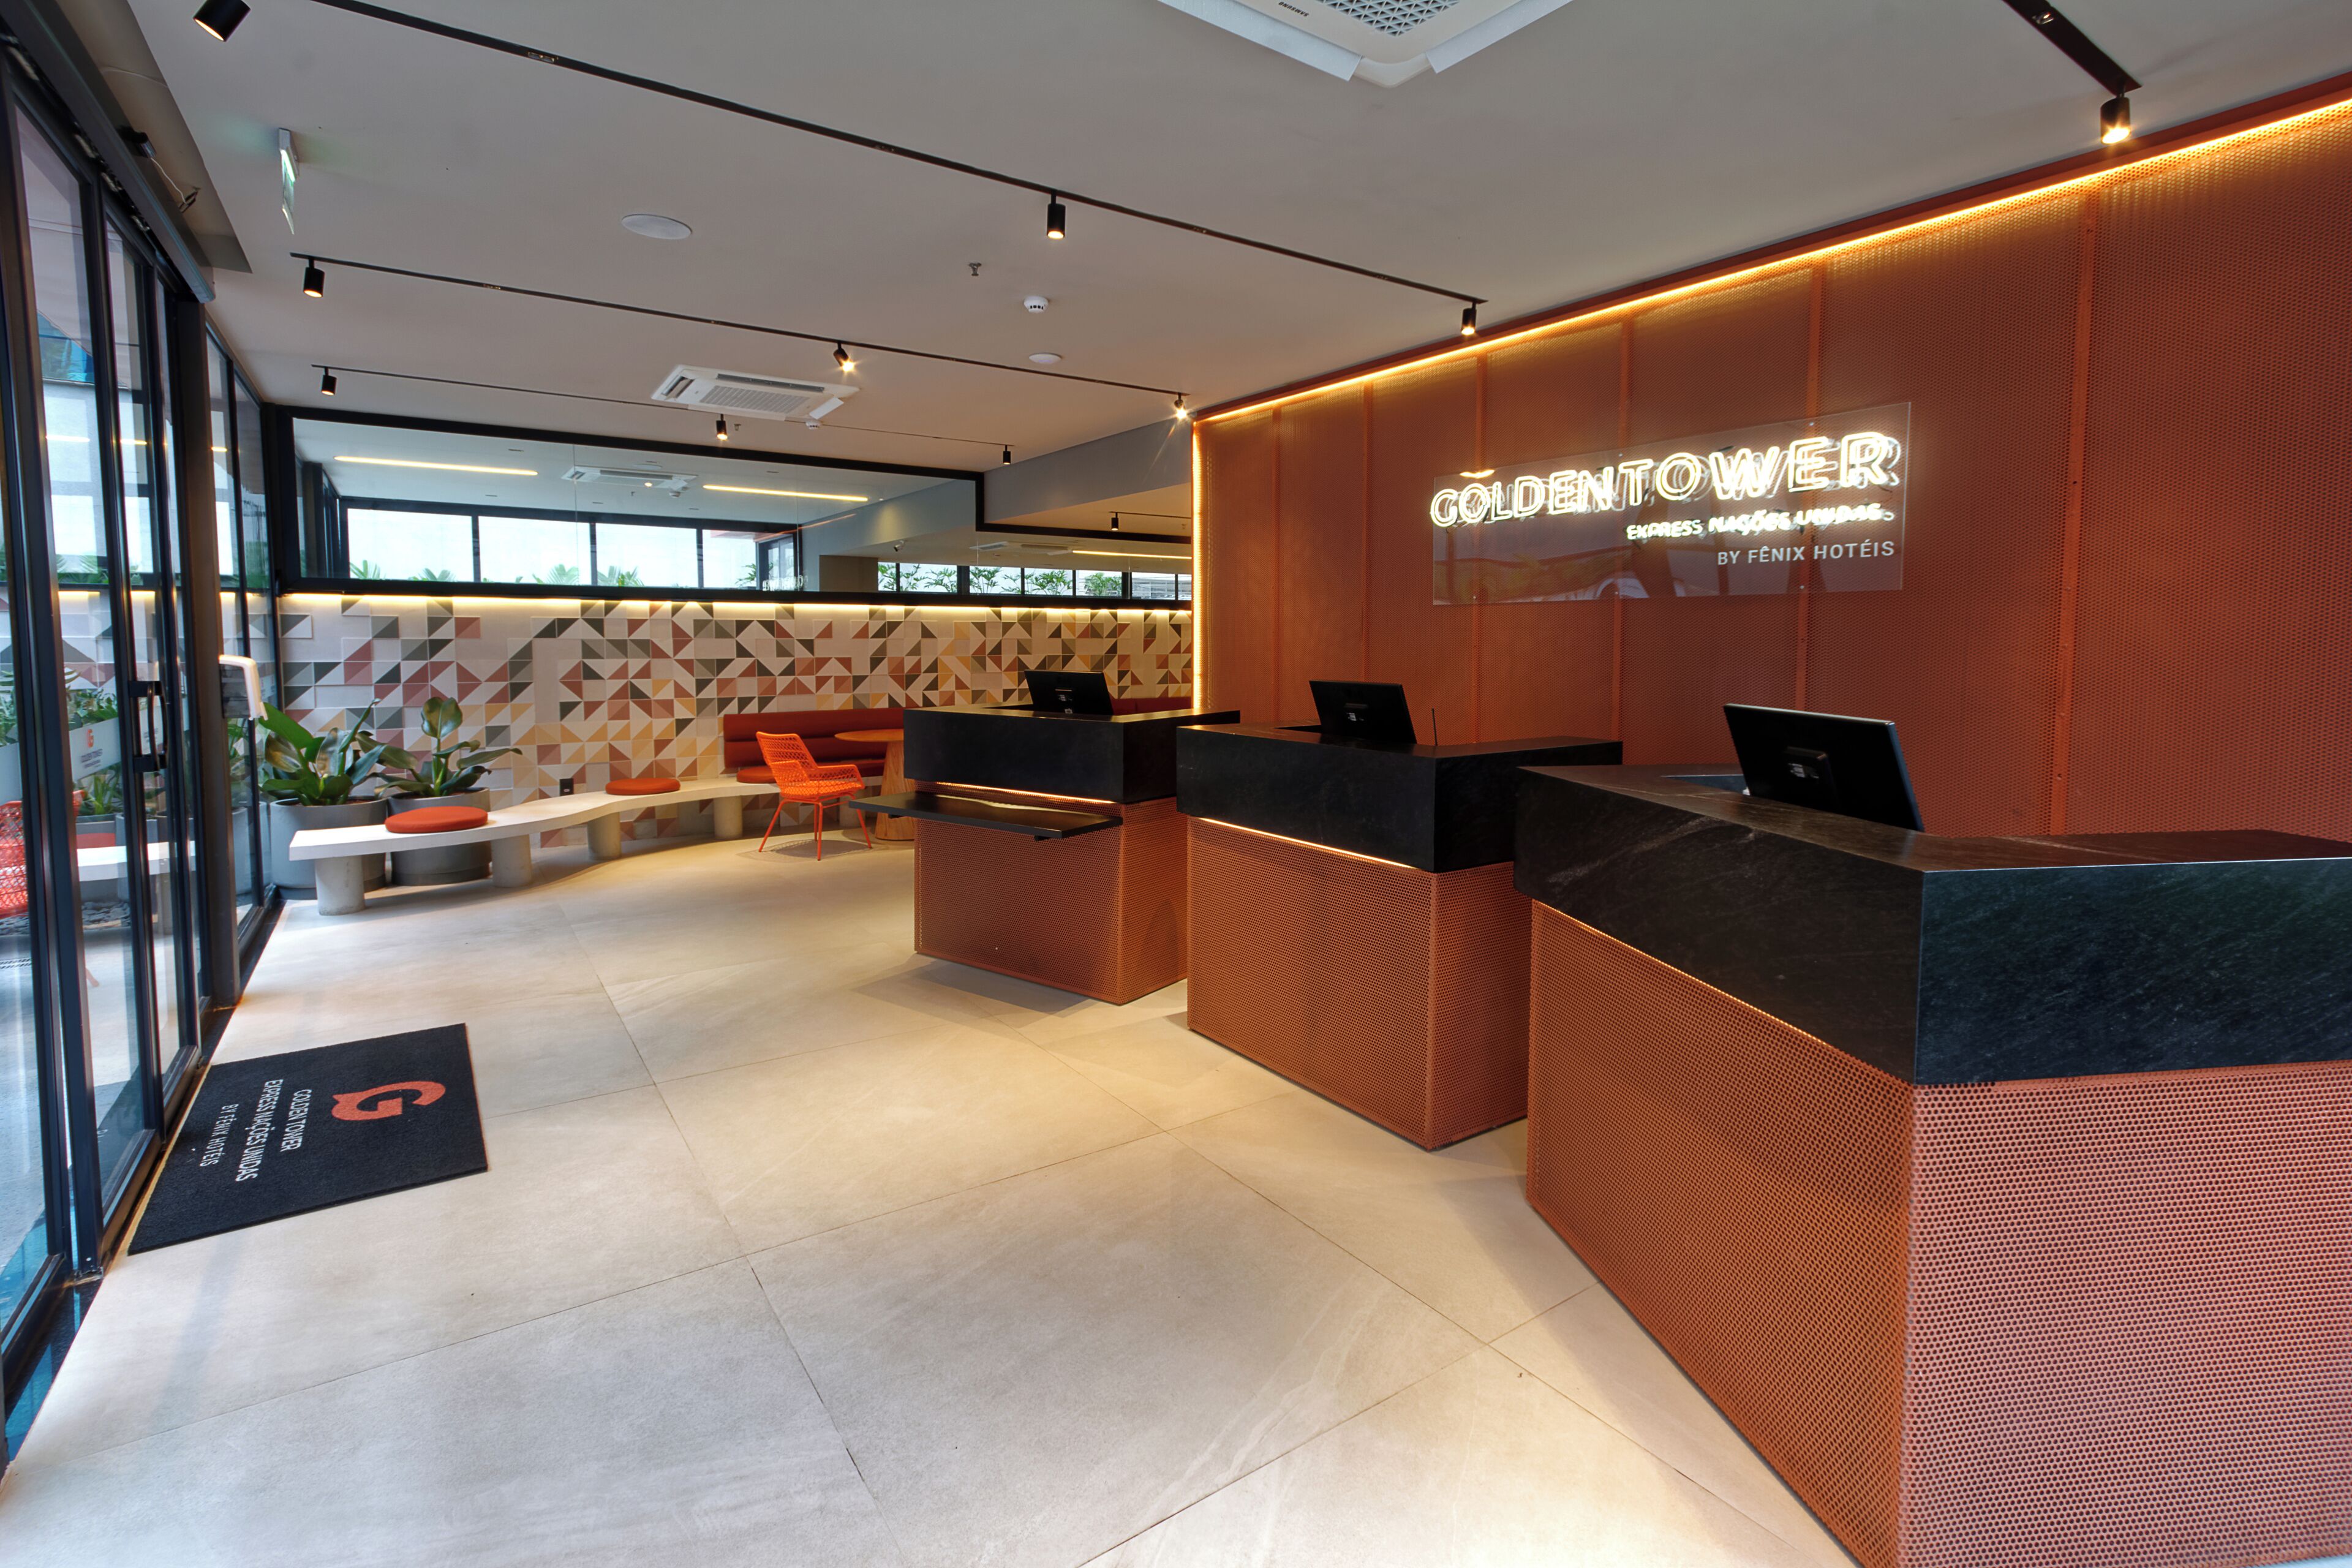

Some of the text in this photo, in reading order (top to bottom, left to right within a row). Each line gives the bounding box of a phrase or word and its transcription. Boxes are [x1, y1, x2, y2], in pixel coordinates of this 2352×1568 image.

[1278, 1, 1310, 17] SAMSUNG
[1626, 519, 1703, 540] EXPRESS
[1717, 539, 1895, 565] BY FÊNIX HOTÉIS
[199, 1103, 239, 1167] BY FÊNIX HOTÉIS
[235, 1079, 284, 1182] EXPRESS NAÇÕES UNIDAS
